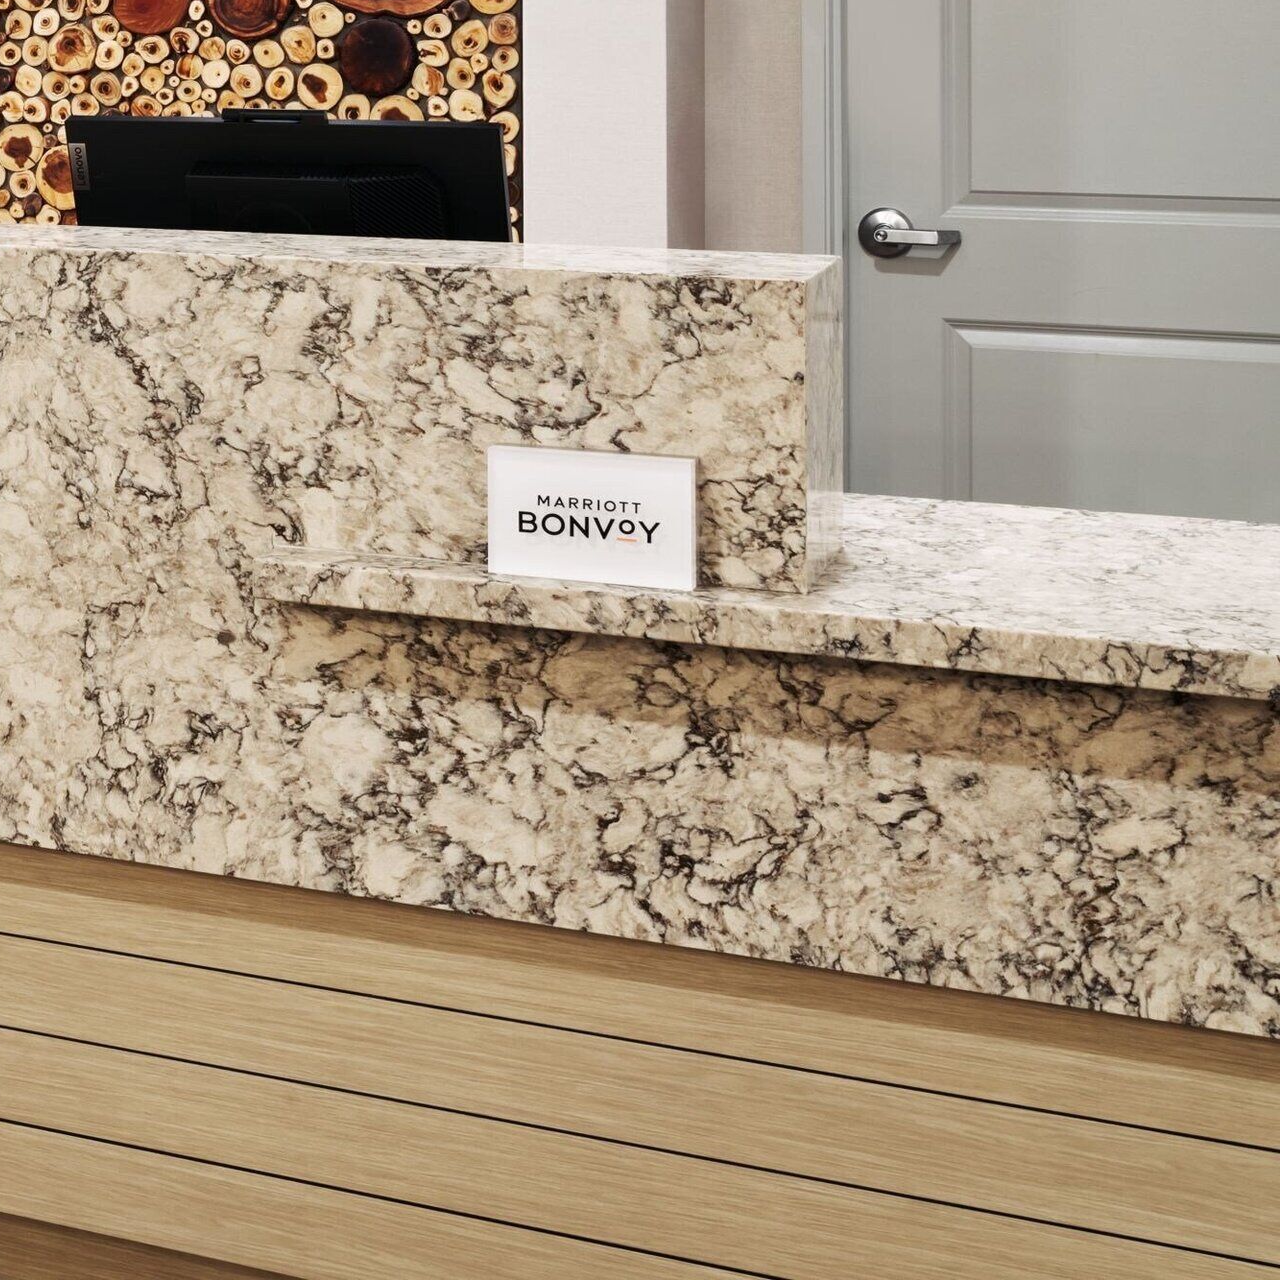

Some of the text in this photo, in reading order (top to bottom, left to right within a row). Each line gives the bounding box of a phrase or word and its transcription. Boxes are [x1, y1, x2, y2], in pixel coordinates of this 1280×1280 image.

[74, 146, 86, 186] Lenovo
[537, 495, 642, 514] MARRIOTT
[518, 510, 660, 544] BONVOY
